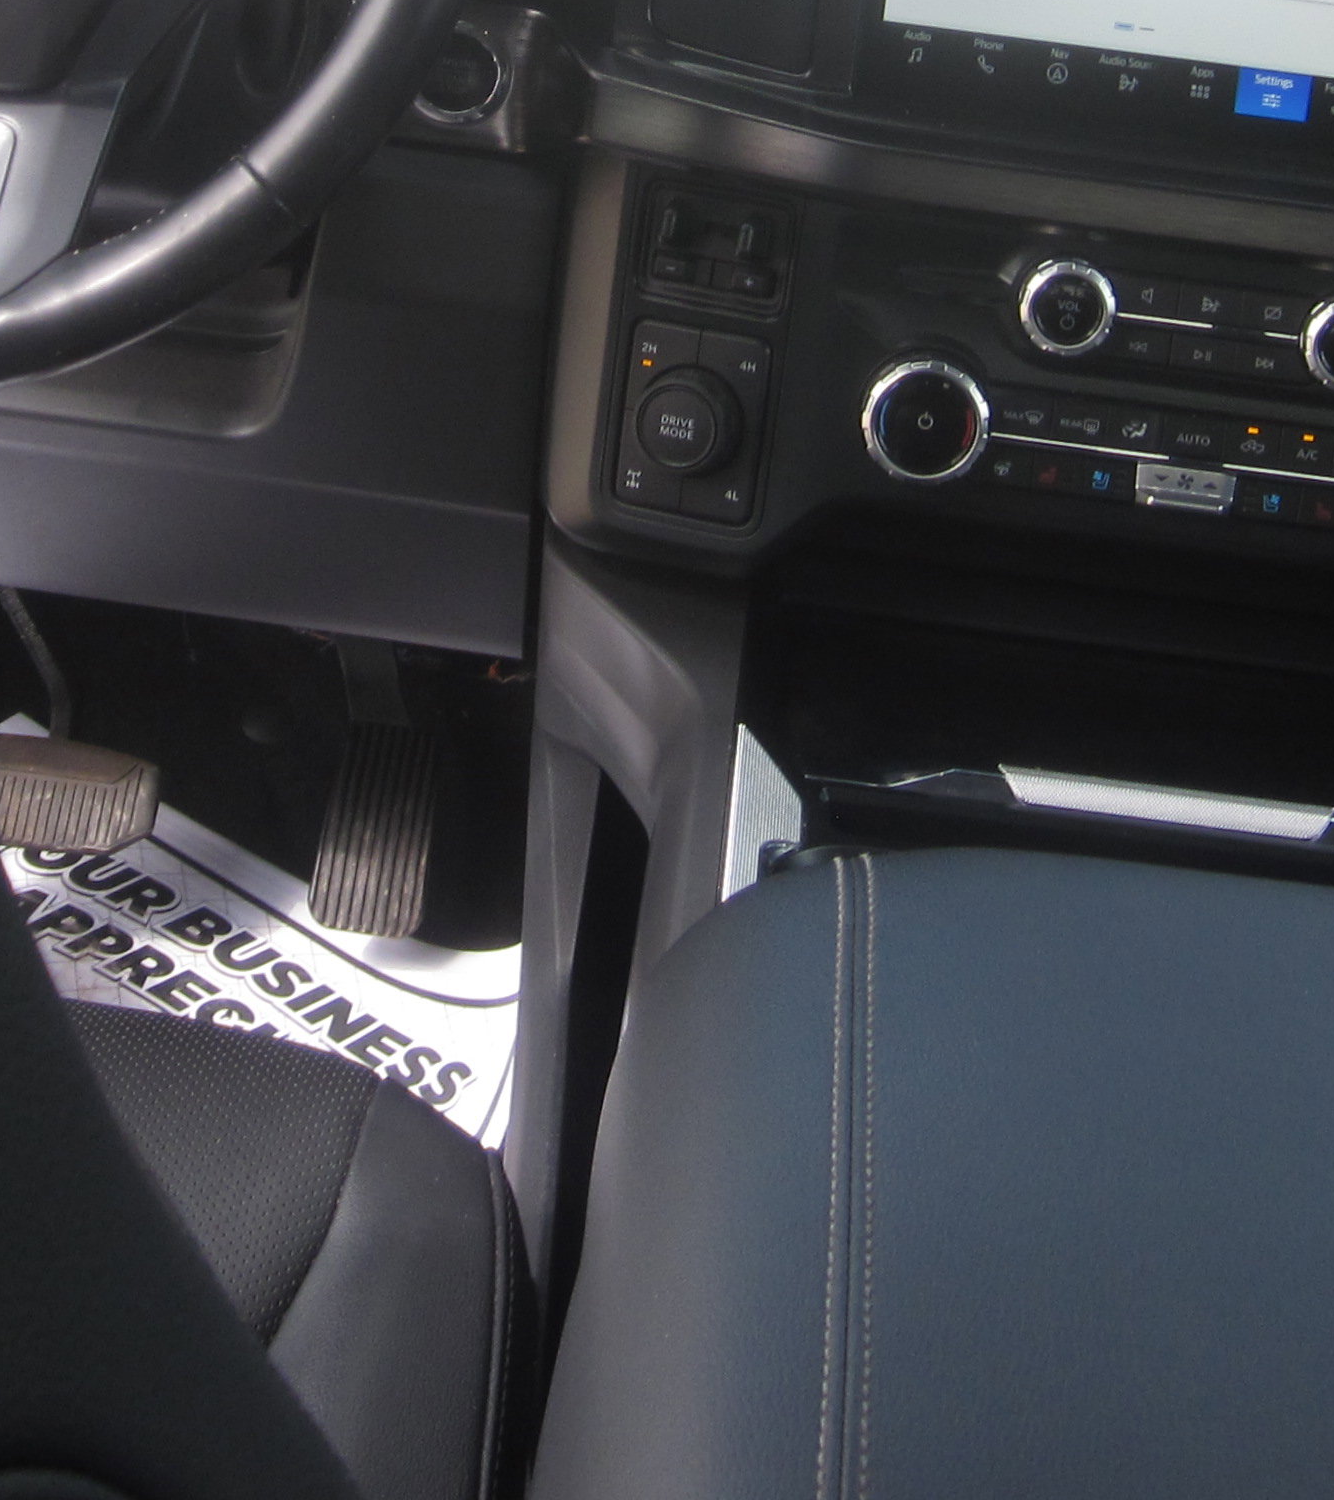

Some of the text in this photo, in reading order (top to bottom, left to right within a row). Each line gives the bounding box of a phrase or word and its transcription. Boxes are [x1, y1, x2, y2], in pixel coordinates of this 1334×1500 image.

[903, 28, 932, 43] Audio
[973, 38, 1004, 52] Phone
[1050, 48, 1070, 60] Nav
[1189, 65, 1215, 80] Apps
[1254, 73, 1294, 90] Settings
[1057, 301, 1082, 314] VOL
[641, 342, 658, 354] 2H
[738, 361, 757, 373] 4H
[660, 414, 696, 429] DRIVE
[659, 425, 695, 441] MODE
[1176, 432, 1211, 447] AUTO
[1296, 448, 1317, 461] A/C
[724, 489, 739, 501] 4L
[172, 905, 472, 1106] BUSINESS
